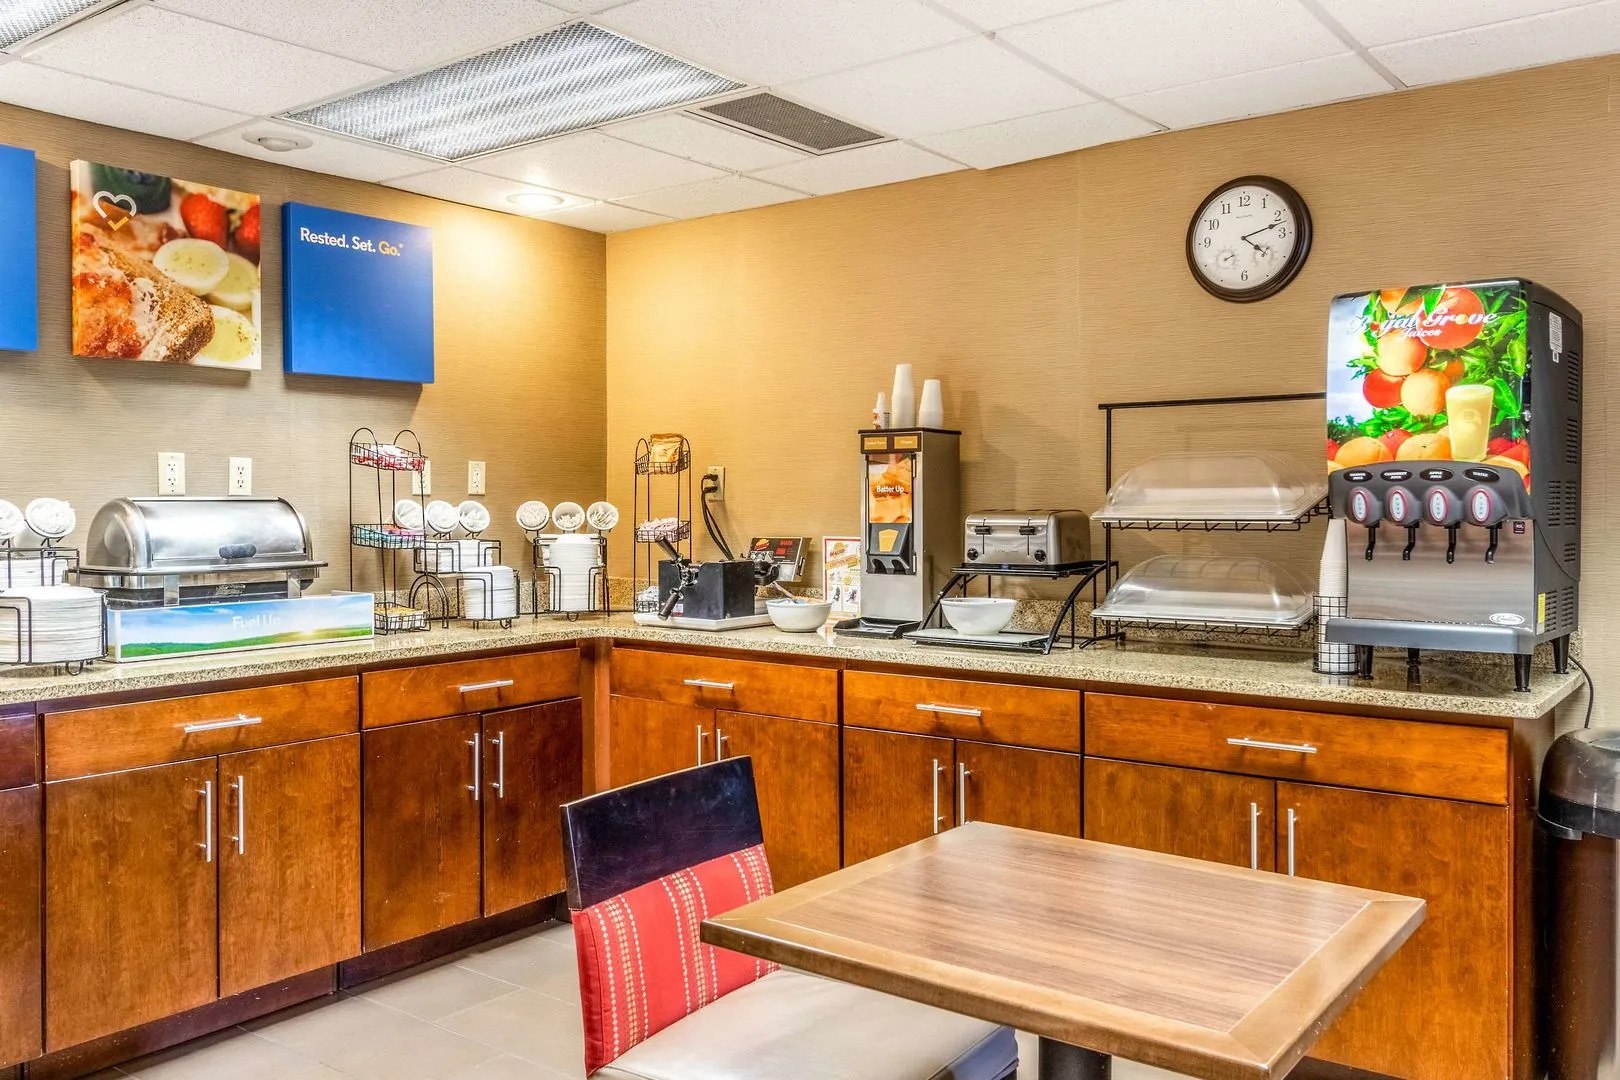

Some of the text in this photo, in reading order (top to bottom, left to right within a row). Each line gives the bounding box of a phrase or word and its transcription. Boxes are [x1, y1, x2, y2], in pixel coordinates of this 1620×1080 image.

[1239, 195, 1251, 207] 12
[1261, 197, 1267, 209] 1
[1221, 203, 1231, 215] 11
[1274, 210, 1282, 222] 2
[1208, 218, 1220, 231] 10
[1278, 227, 1286, 239] 3
[300, 226, 350, 249] Rested.
[351, 235, 376, 253] Set.
[1204, 237, 1211, 248] 9
[1240, 270, 1248, 281] 6
[1423, 307, 1500, 328] Grove
[876, 484, 905, 494] Batter Up
[231, 613, 281, 630] Fuel Up
